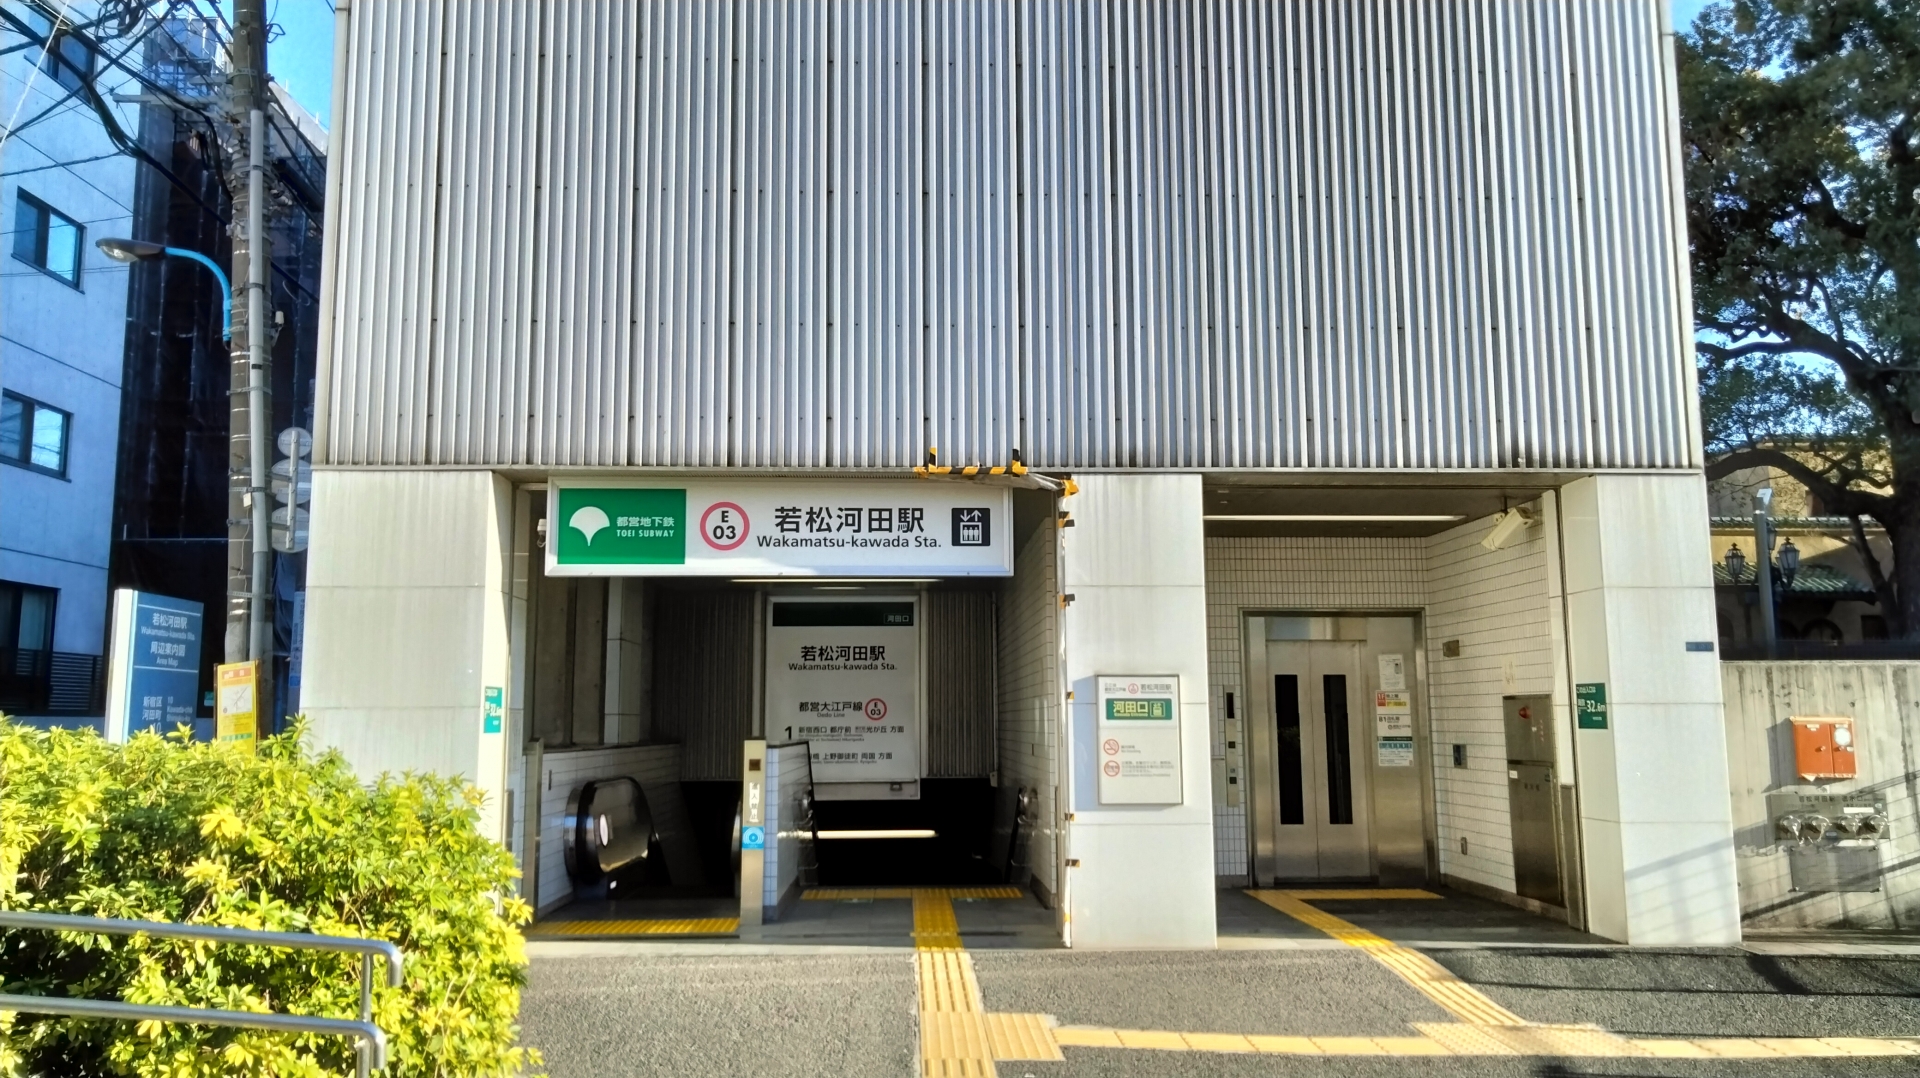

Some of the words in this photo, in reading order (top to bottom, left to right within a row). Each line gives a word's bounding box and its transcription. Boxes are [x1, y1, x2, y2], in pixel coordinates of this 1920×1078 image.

[616, 516, 675, 528] 都営地下鉄
[721, 510, 730, 524] E
[774, 506, 925, 534] 若松河田駅
[616, 529, 637, 538] TOEI
[638, 529, 675, 538] SUBWAY
[712, 525, 737, 540] 03
[757, 534, 911, 548] Wakamatsu-kawada
[914, 535, 942, 548] Sta.
[152, 612, 188, 630] 若松河田駅
[886, 614, 910, 623] 河田口
[150, 641, 186, 657] 周辺案内図
[800, 645, 886, 662] 若松河田駅
[156, 656, 168, 666] Area
[168, 657, 179, 668] Map
[788, 662, 879, 671] Wakamatsu-kawada
[881, 662, 898, 671] Sta.
[1140, 683, 1172, 691] 若松河田駅
[143, 695, 163, 708] 新宿区
[799, 701, 864, 712] 都営大江戸線
[1113, 700, 1148, 713] 河田口
[142, 709, 163, 721] 河田町
[784, 726, 793, 740] 1
[798, 726, 827, 734] 新宿西口
[830, 726, 852, 734] 都庁前
[865, 726, 887, 734] 光が丘
[890, 726, 905, 734] 方面
[822, 752, 859, 760] 上野御徒町
[861, 752, 876, 760] 両国
[878, 752, 893, 760] 方面
